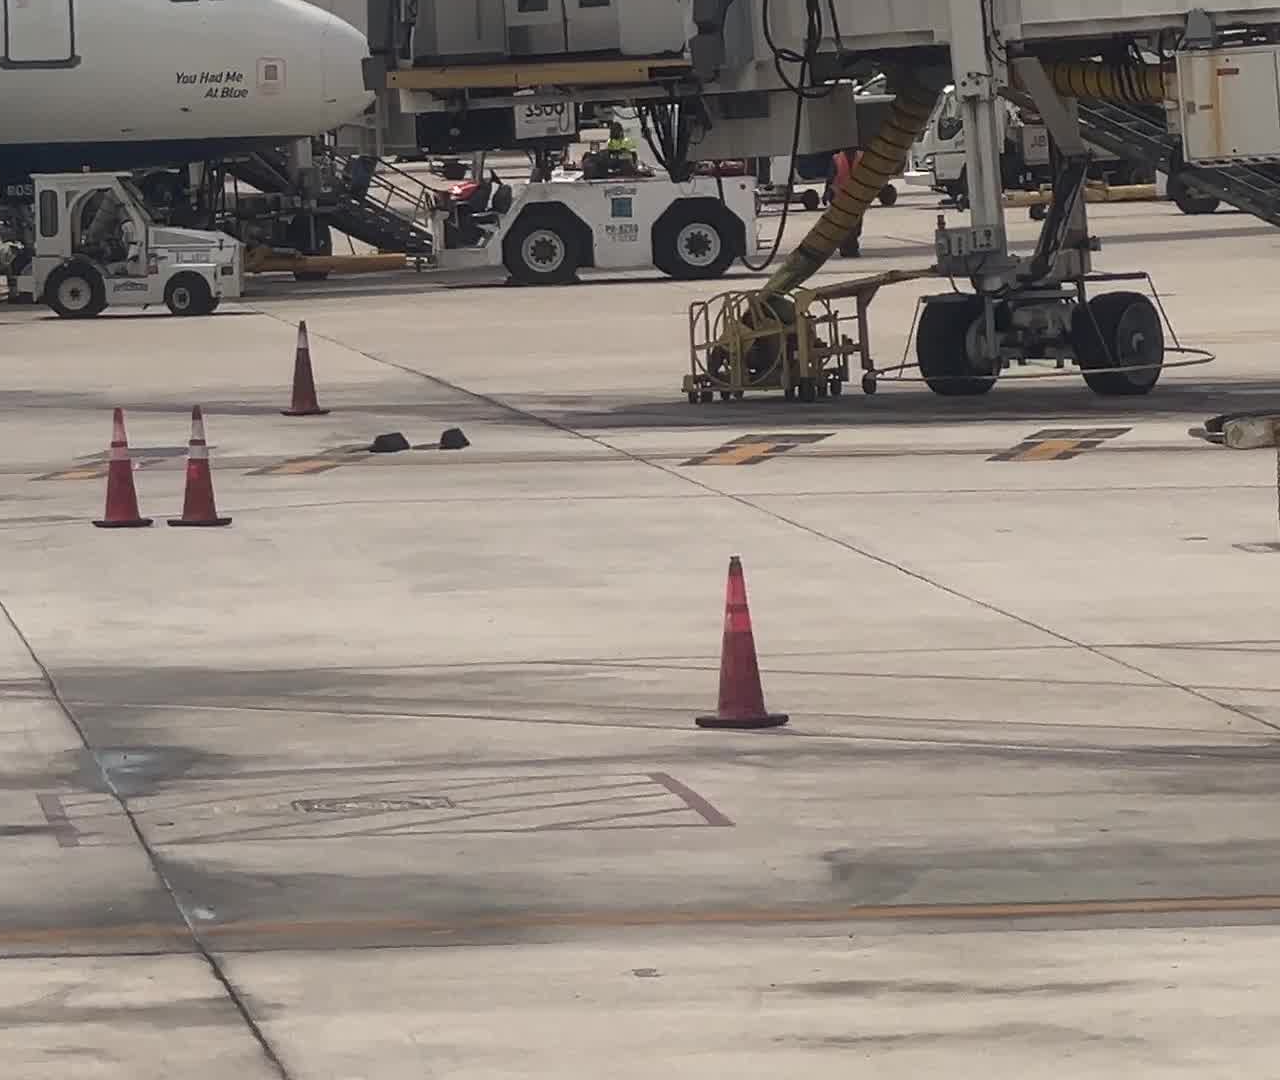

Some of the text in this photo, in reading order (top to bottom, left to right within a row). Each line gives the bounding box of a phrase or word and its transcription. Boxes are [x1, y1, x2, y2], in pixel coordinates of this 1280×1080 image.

[176, 71, 243, 84] You Had Me
[220, 87, 248, 98] Blue
